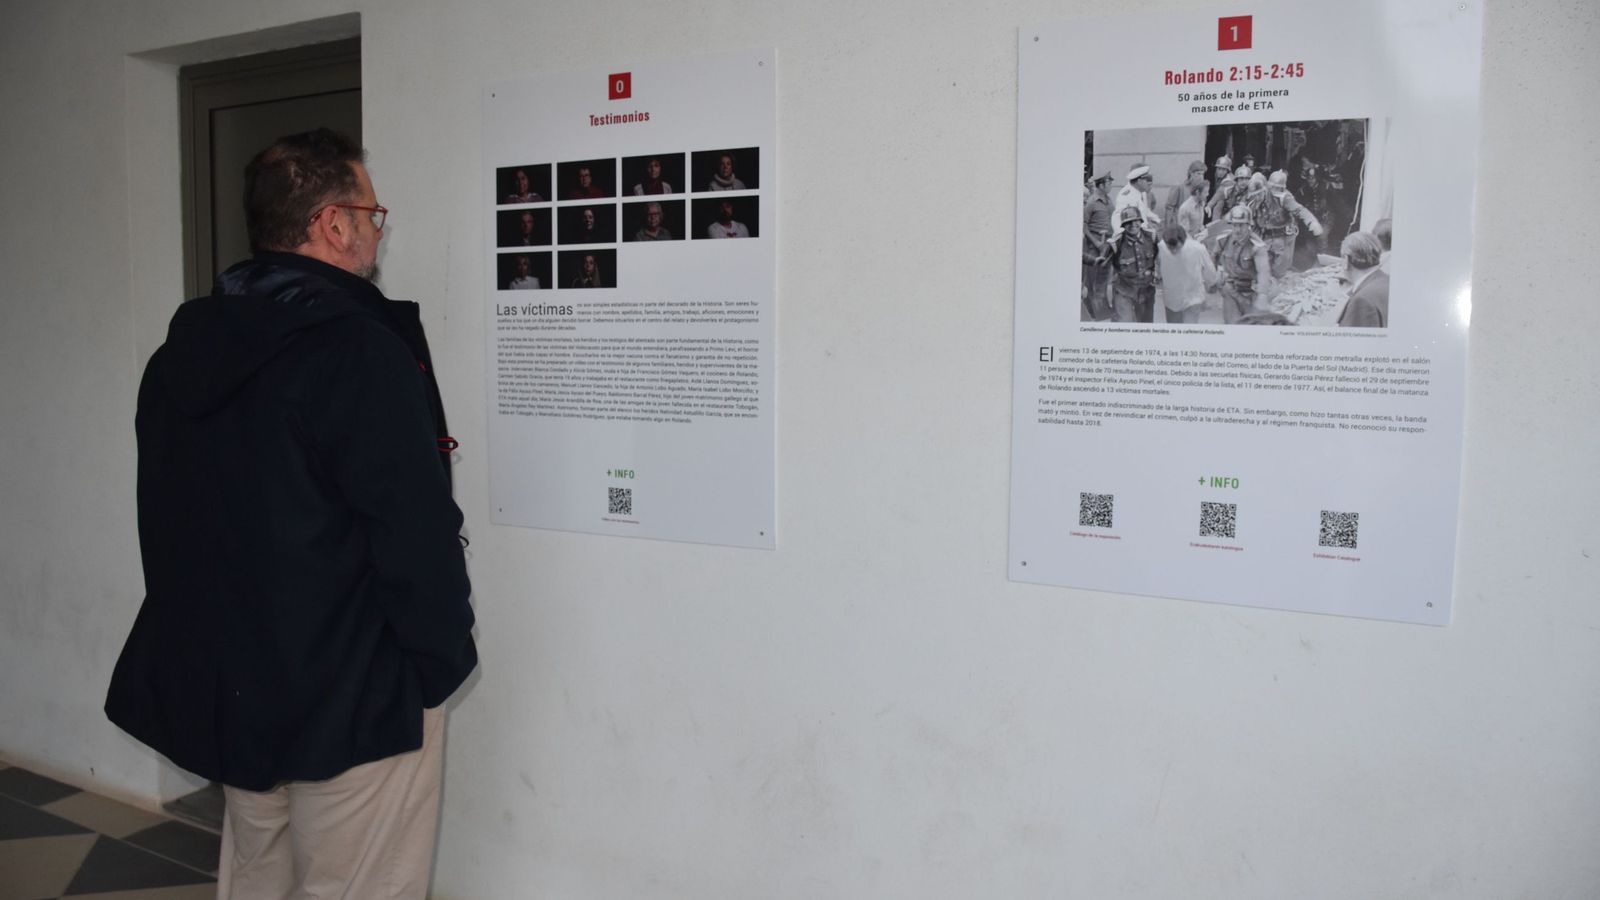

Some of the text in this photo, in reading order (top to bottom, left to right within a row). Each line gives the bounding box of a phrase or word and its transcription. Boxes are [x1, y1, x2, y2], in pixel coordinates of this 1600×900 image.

[1230, 26, 1238, 42] 1
[1165, 63, 1304, 85] Rolando 2:15-2:45
[616, 80, 624, 93] 0
[1178, 88, 1289, 102] 50 años de la primera
[1192, 101, 1274, 114] masacre de ETA
[589, 110, 650, 127] Testimonios
[496, 303, 573, 316] Las víctimas
[1039, 346, 1054, 362] El
[1100, 348, 1134, 356] septiembre
[1234, 352, 1259, 360] potente
[1364, 355, 1390, 364] explotó
[1074, 375, 1102, 384] inspector
[1118, 377, 1137, 386] Ayuso
[1182, 379, 1202, 388] policía
[1389, 377, 1430, 386] septiembre
[1058, 398, 1077, 407] primer
[1107, 401, 1154, 409] indiscriminado
[1172, 404, 1188, 412] larga
[1112, 411, 1145, 419] reivindicar
[1179, 414, 1197, 423] culpó
[1212, 416, 1254, 424] ultraderecha
[1269, 418, 1297, 427] régimen
[1350, 422, 1386, 430] reconoció
[615, 469, 634, 479] INFO
[1210, 476, 1239, 490] INFO
